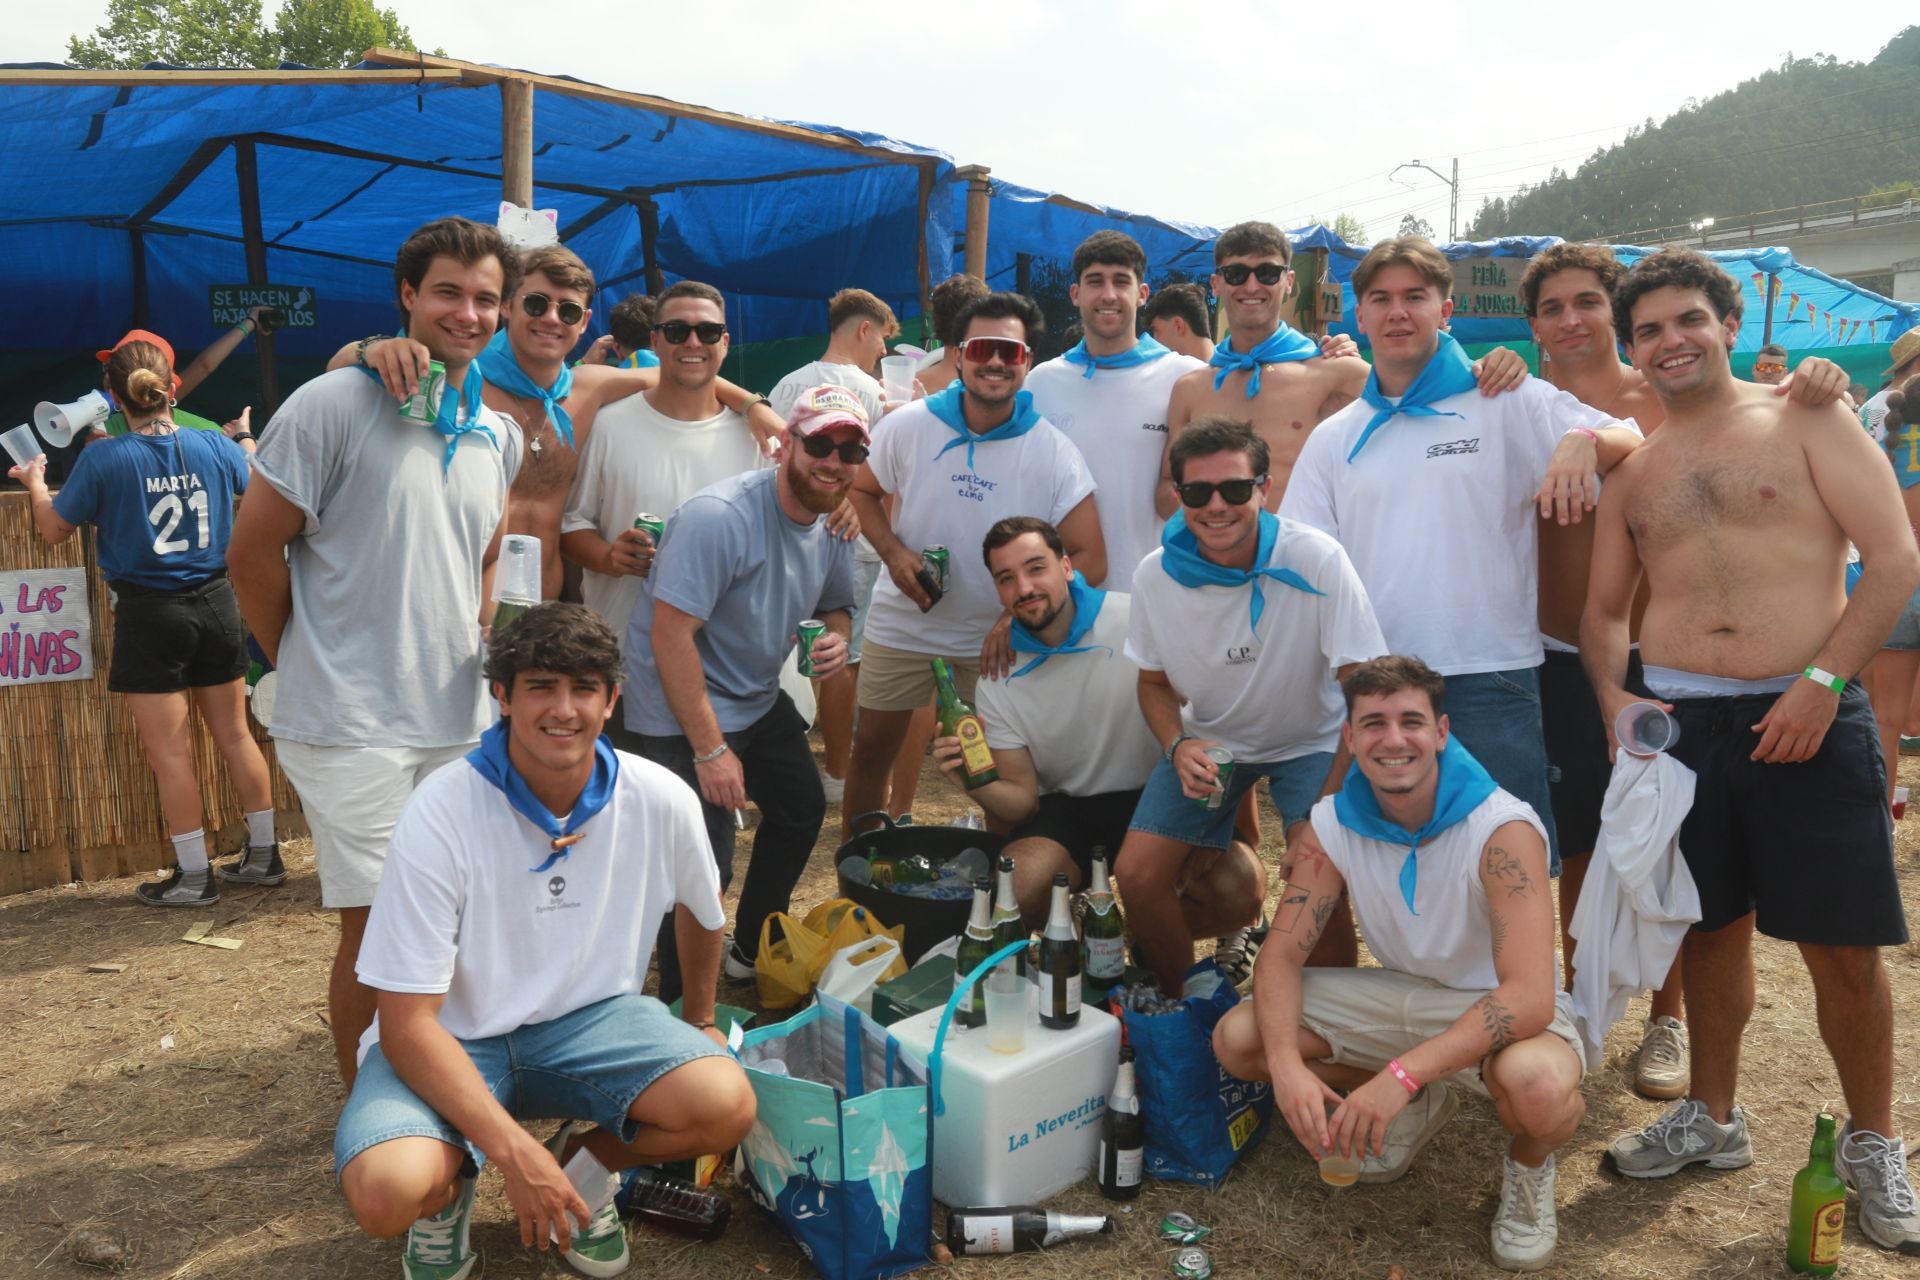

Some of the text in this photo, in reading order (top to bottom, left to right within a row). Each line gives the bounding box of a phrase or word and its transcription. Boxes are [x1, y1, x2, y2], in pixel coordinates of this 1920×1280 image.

[1472, 260, 1507, 287] PEÑA
[214, 290, 291, 306] SE HACEN
[1451, 293, 1470, 313] LA
[213, 308, 251, 324] PAJA
[146, 473, 202, 493] MARTA
[149, 490, 210, 555] 21
[18, 583, 66, 613] LAS
[1008, 1133, 1029, 1153] La
[1035, 1094, 1105, 1140] Neverita
